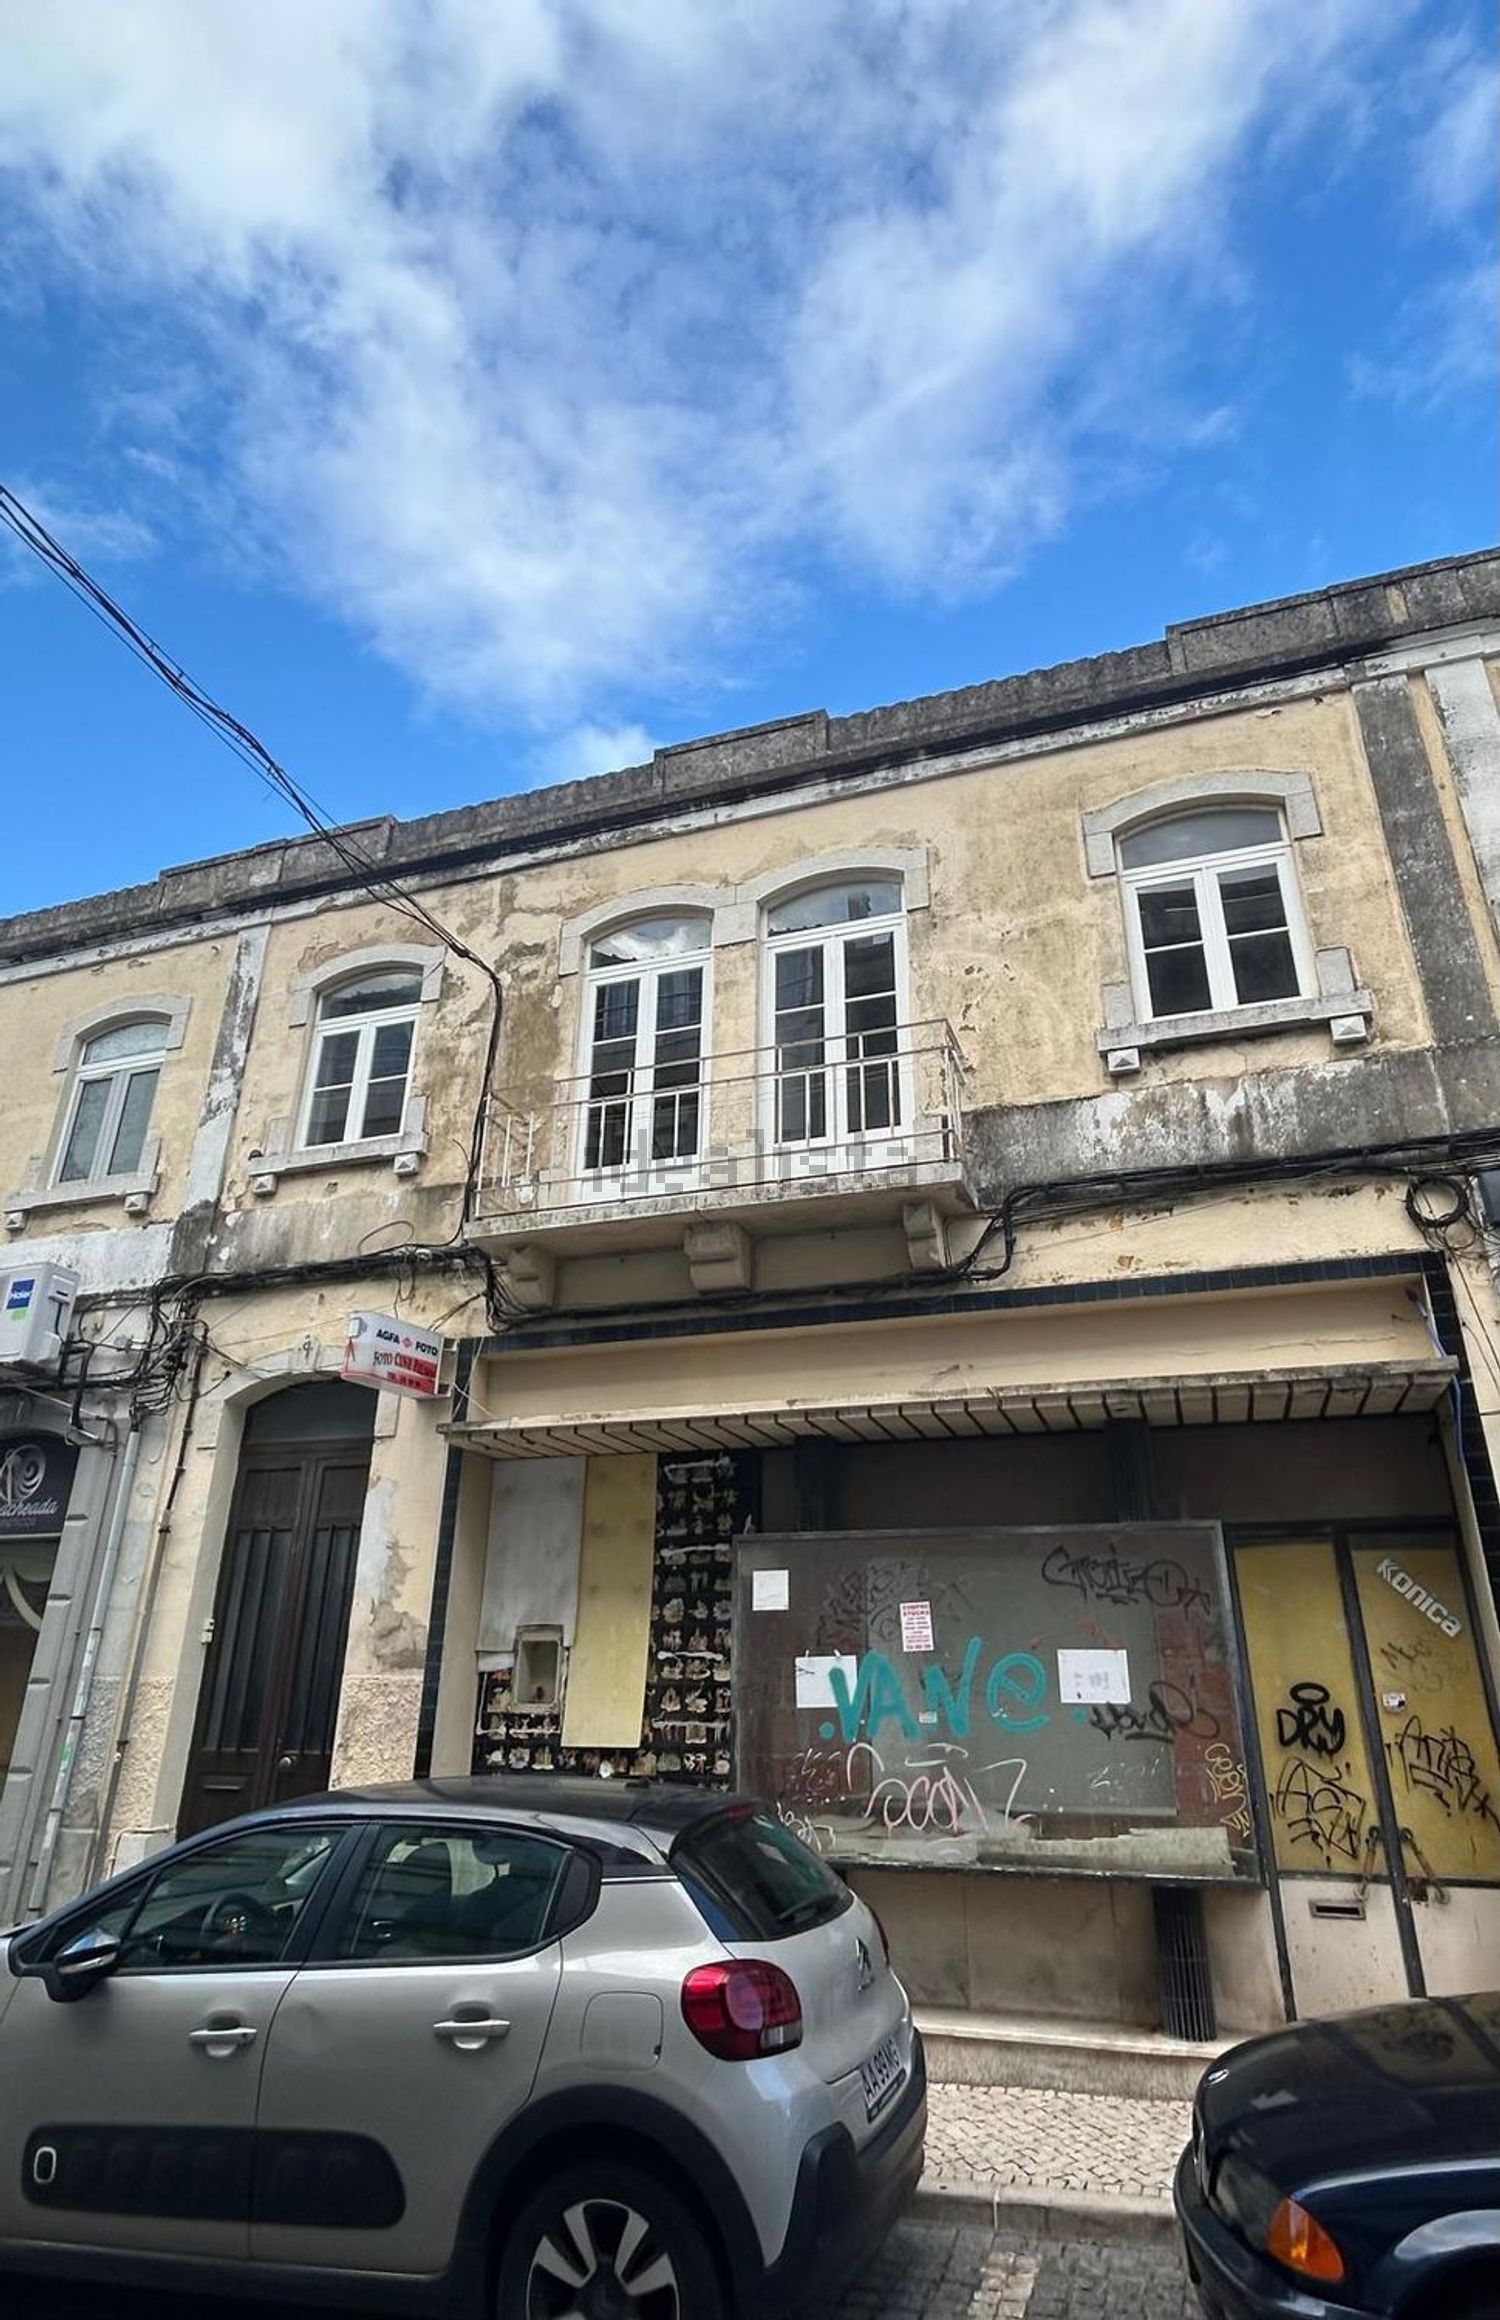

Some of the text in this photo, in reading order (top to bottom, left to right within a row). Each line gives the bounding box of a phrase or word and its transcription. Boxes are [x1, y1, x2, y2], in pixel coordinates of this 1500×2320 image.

[376, 1328, 438, 1355] AGFA FOTO
[1376, 1558, 1463, 1638] Konica
